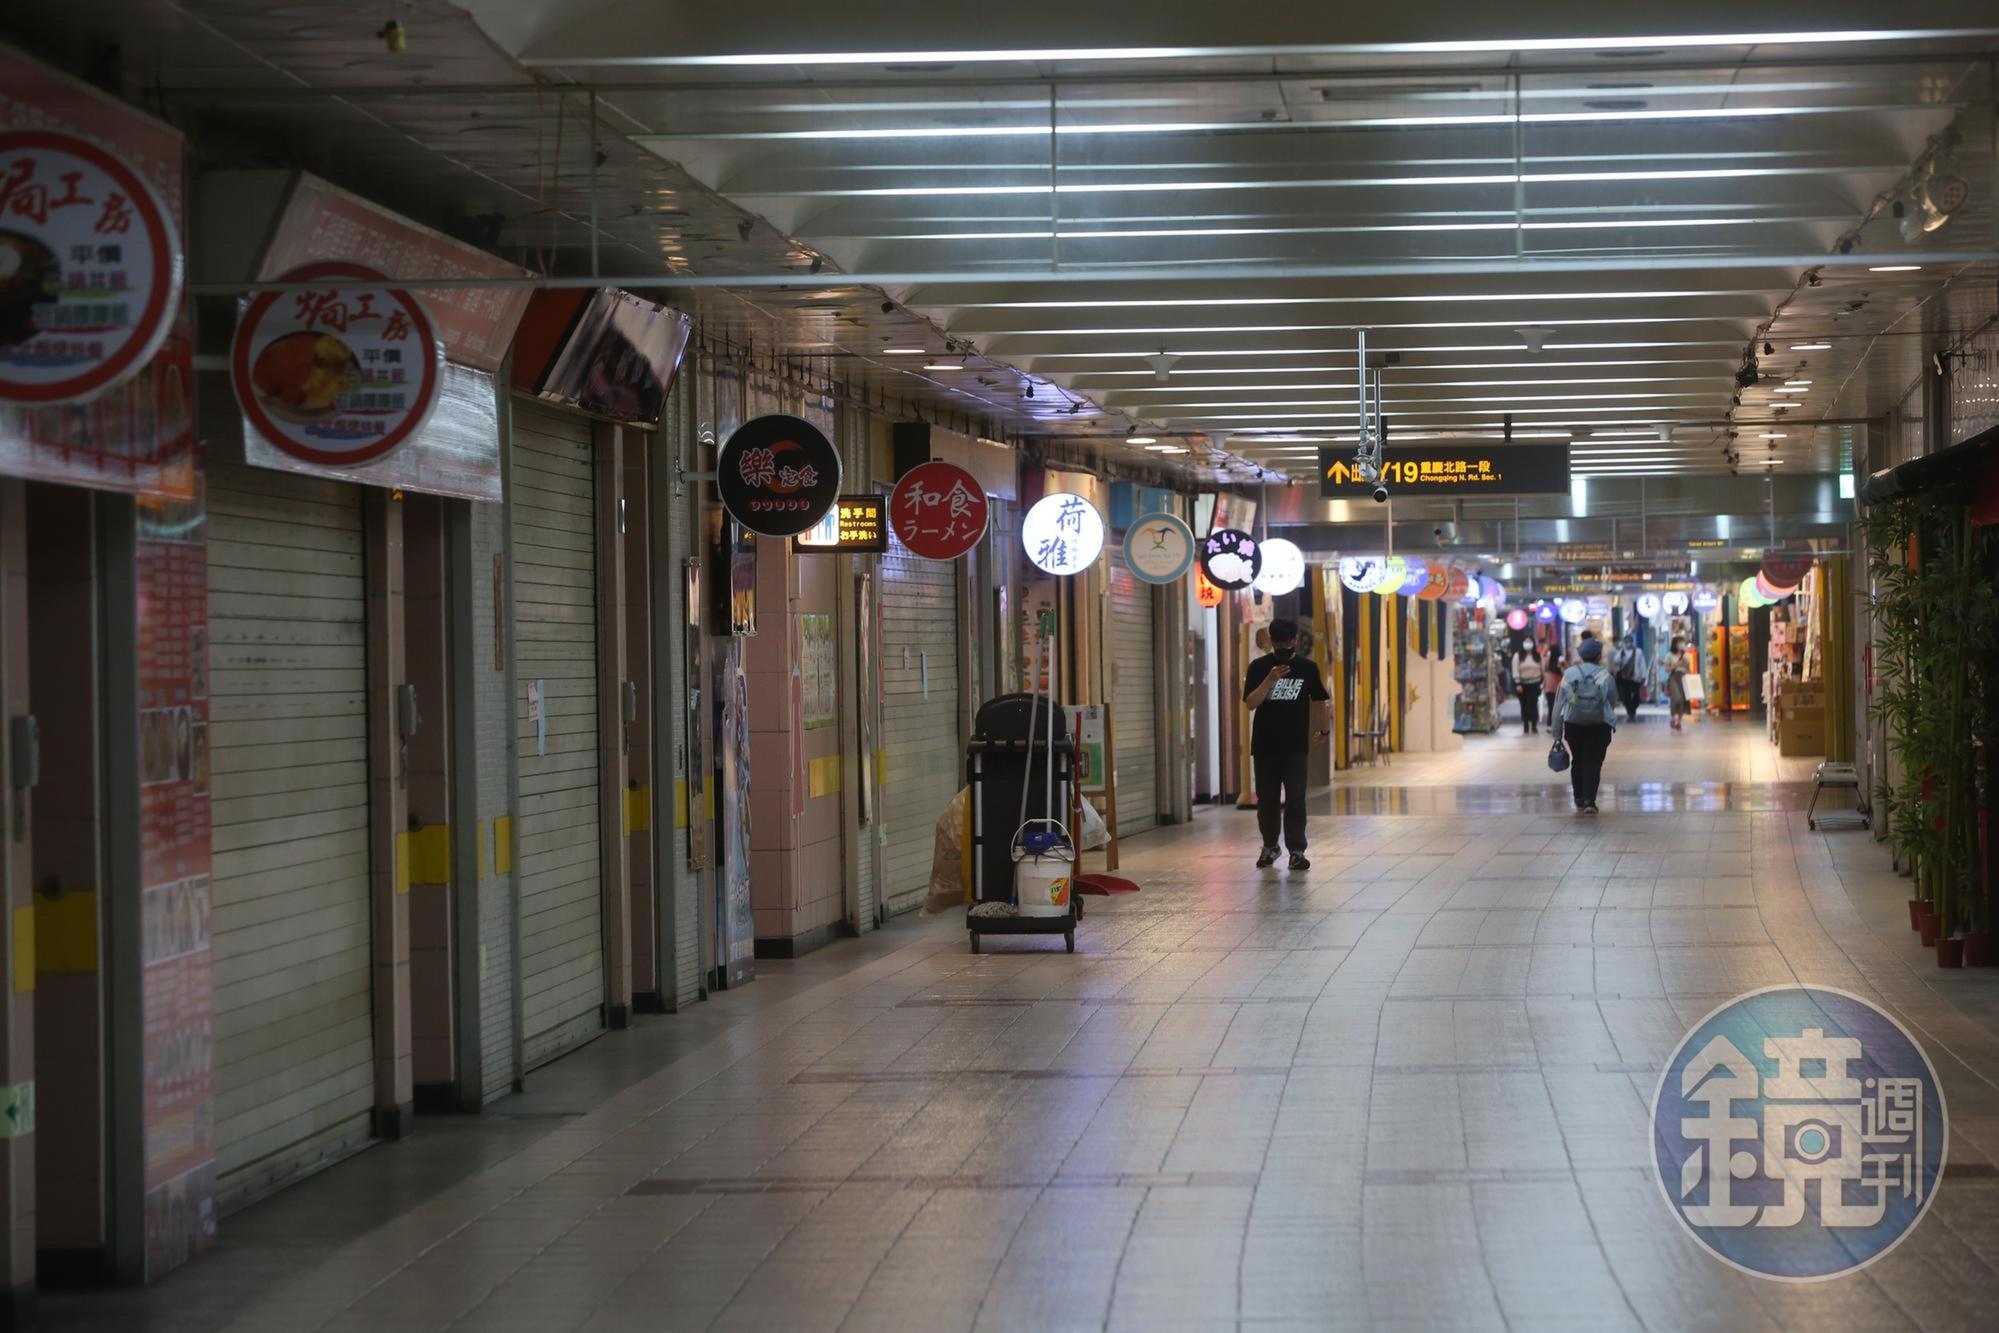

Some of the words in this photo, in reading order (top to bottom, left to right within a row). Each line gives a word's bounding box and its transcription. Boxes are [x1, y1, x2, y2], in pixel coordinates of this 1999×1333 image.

[1420, 461, 1491, 474] 重慶北路一段
[1420, 474, 1457, 483] Chongqing
[903, 479, 979, 519] 和食
[840, 507, 877, 519] 洗手間
[840, 530, 877, 541] お手洗い
[903, 519, 980, 542] ラーメン
[1275, 678, 1304, 689] BILLIE
